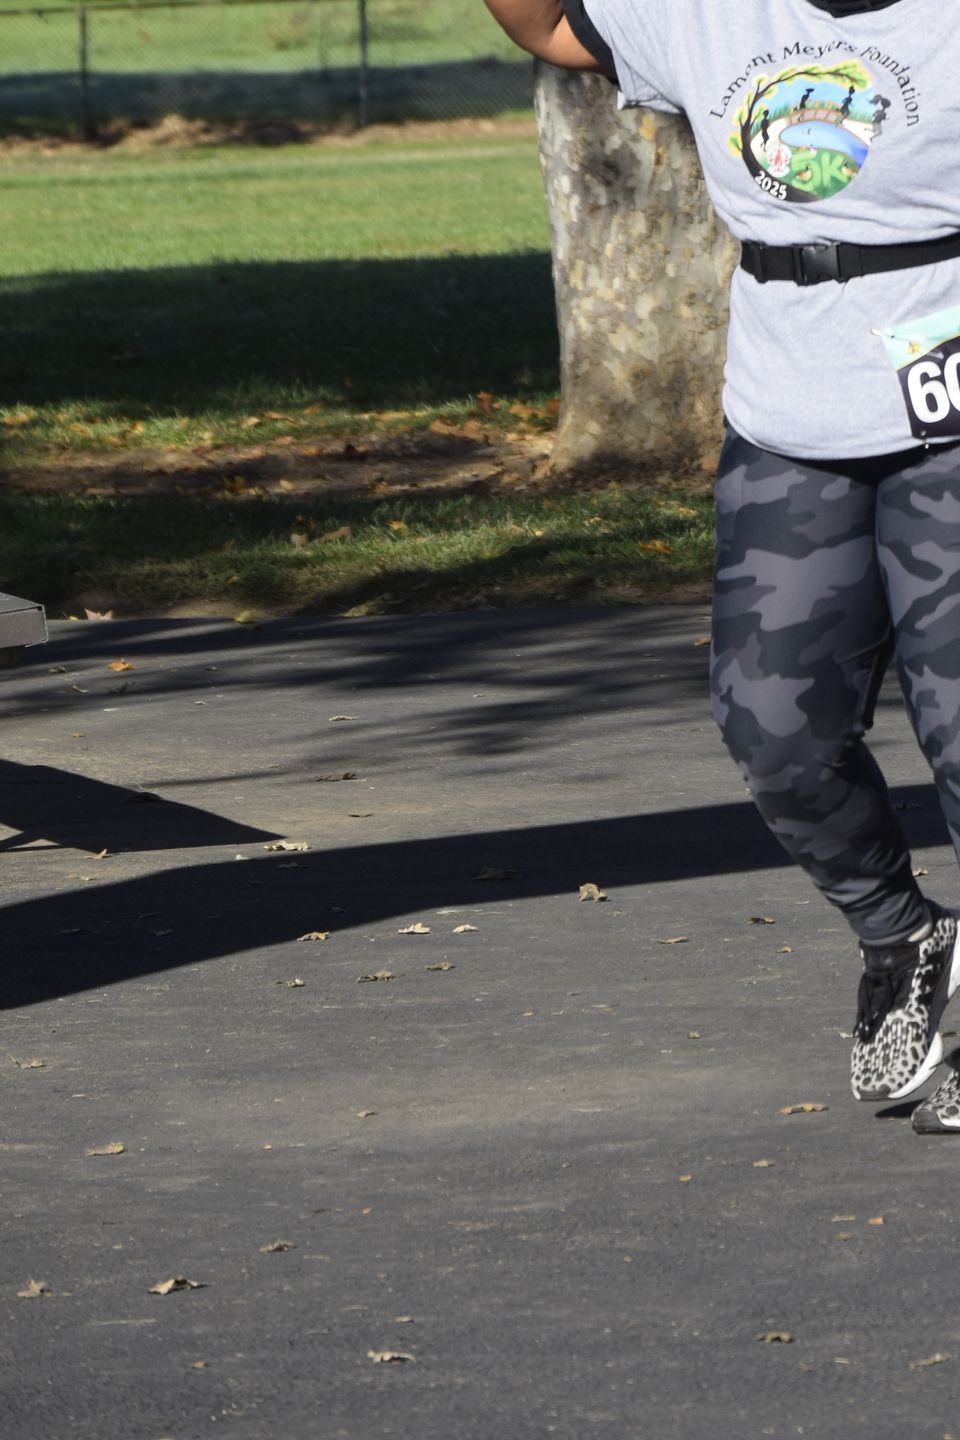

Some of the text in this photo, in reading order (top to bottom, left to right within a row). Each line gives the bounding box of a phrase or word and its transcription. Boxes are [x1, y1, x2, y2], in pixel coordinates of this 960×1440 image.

[710, 53, 777, 118] Lamont
[754, 170, 788, 200] 2025
[790, 152, 852, 189] 5K
